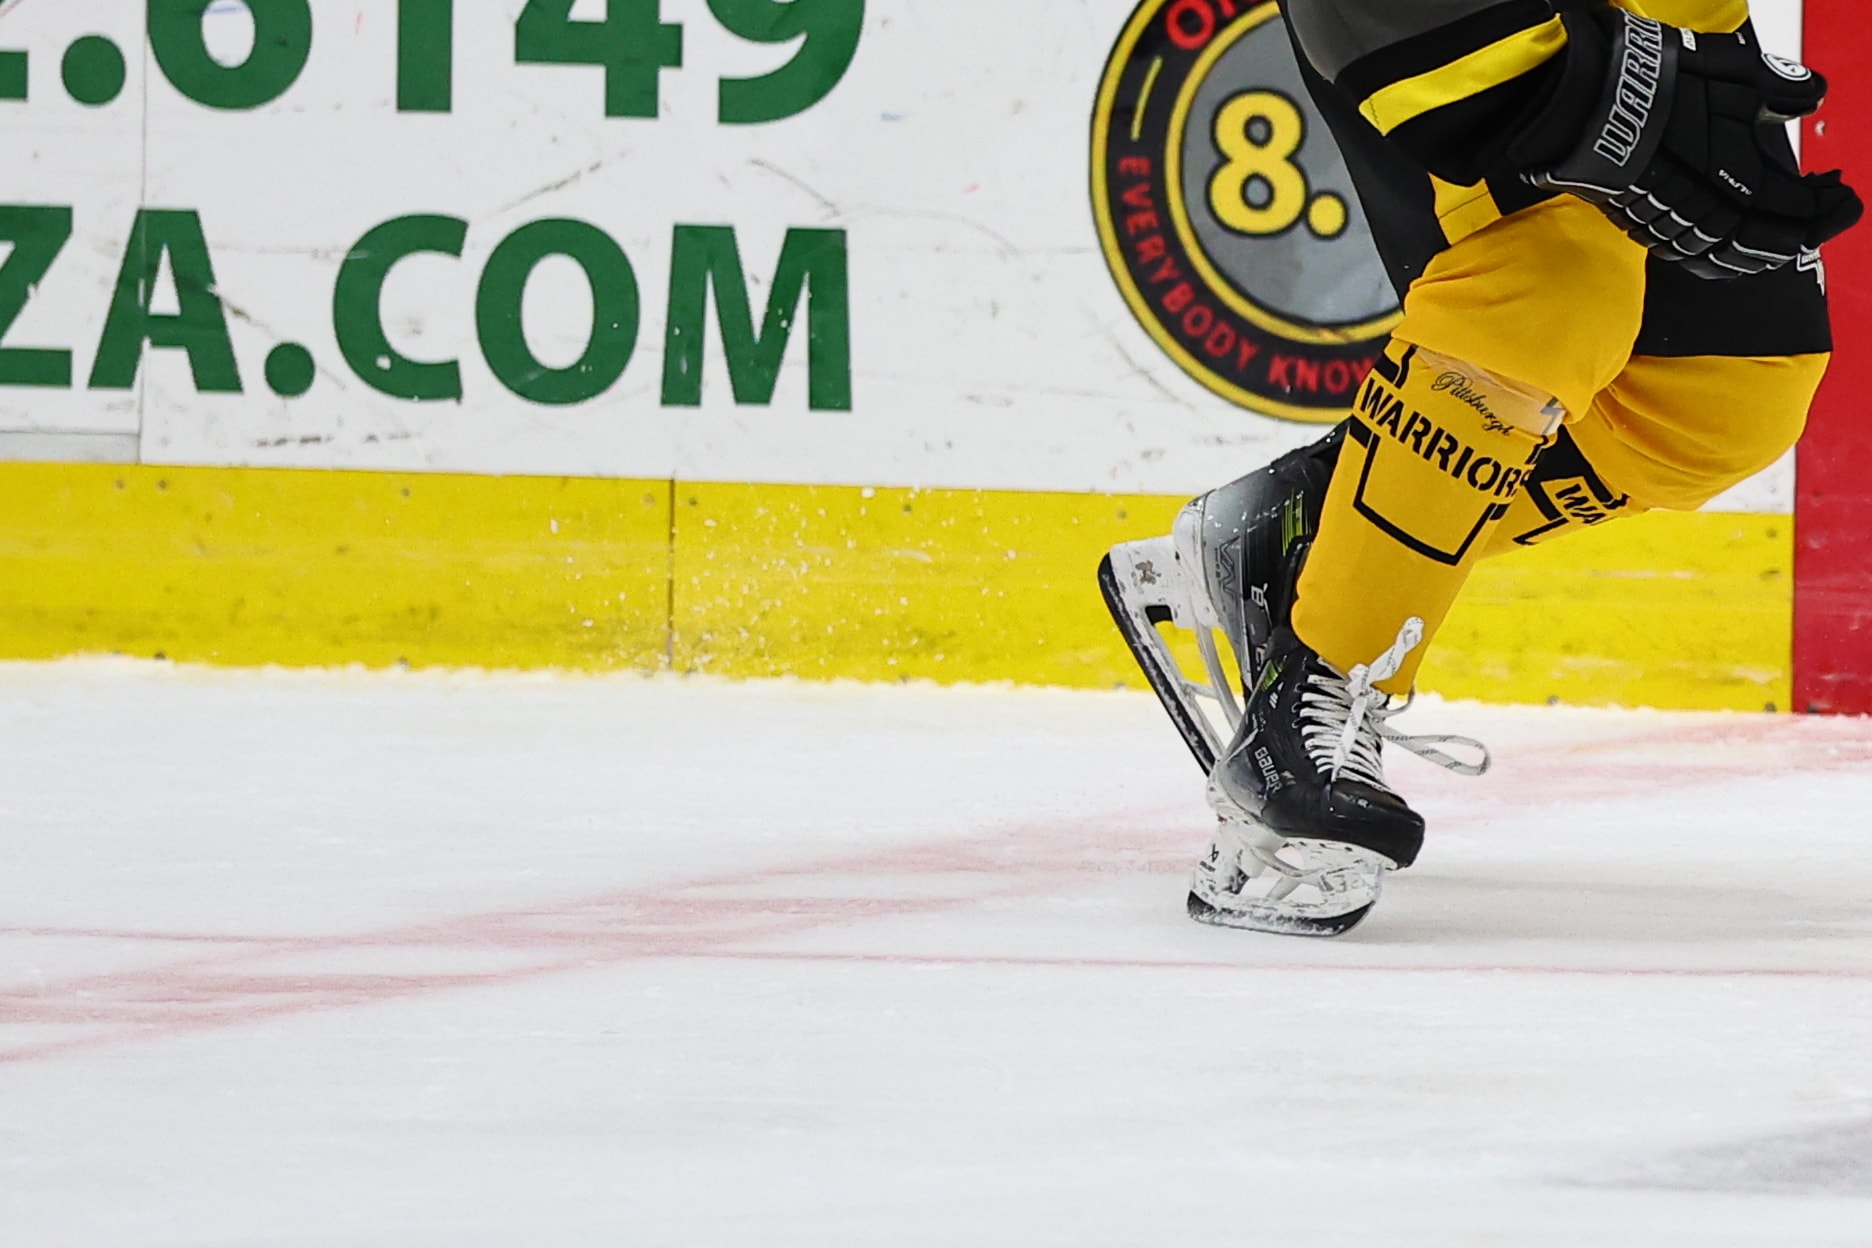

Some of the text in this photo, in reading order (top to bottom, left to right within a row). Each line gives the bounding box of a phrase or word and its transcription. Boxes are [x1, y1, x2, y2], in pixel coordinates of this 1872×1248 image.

[1207, 88, 1349, 239] 8.
[1117, 155, 1261, 372] EVERYBODY
[1430, 370, 1515, 438] Pittsburgh
